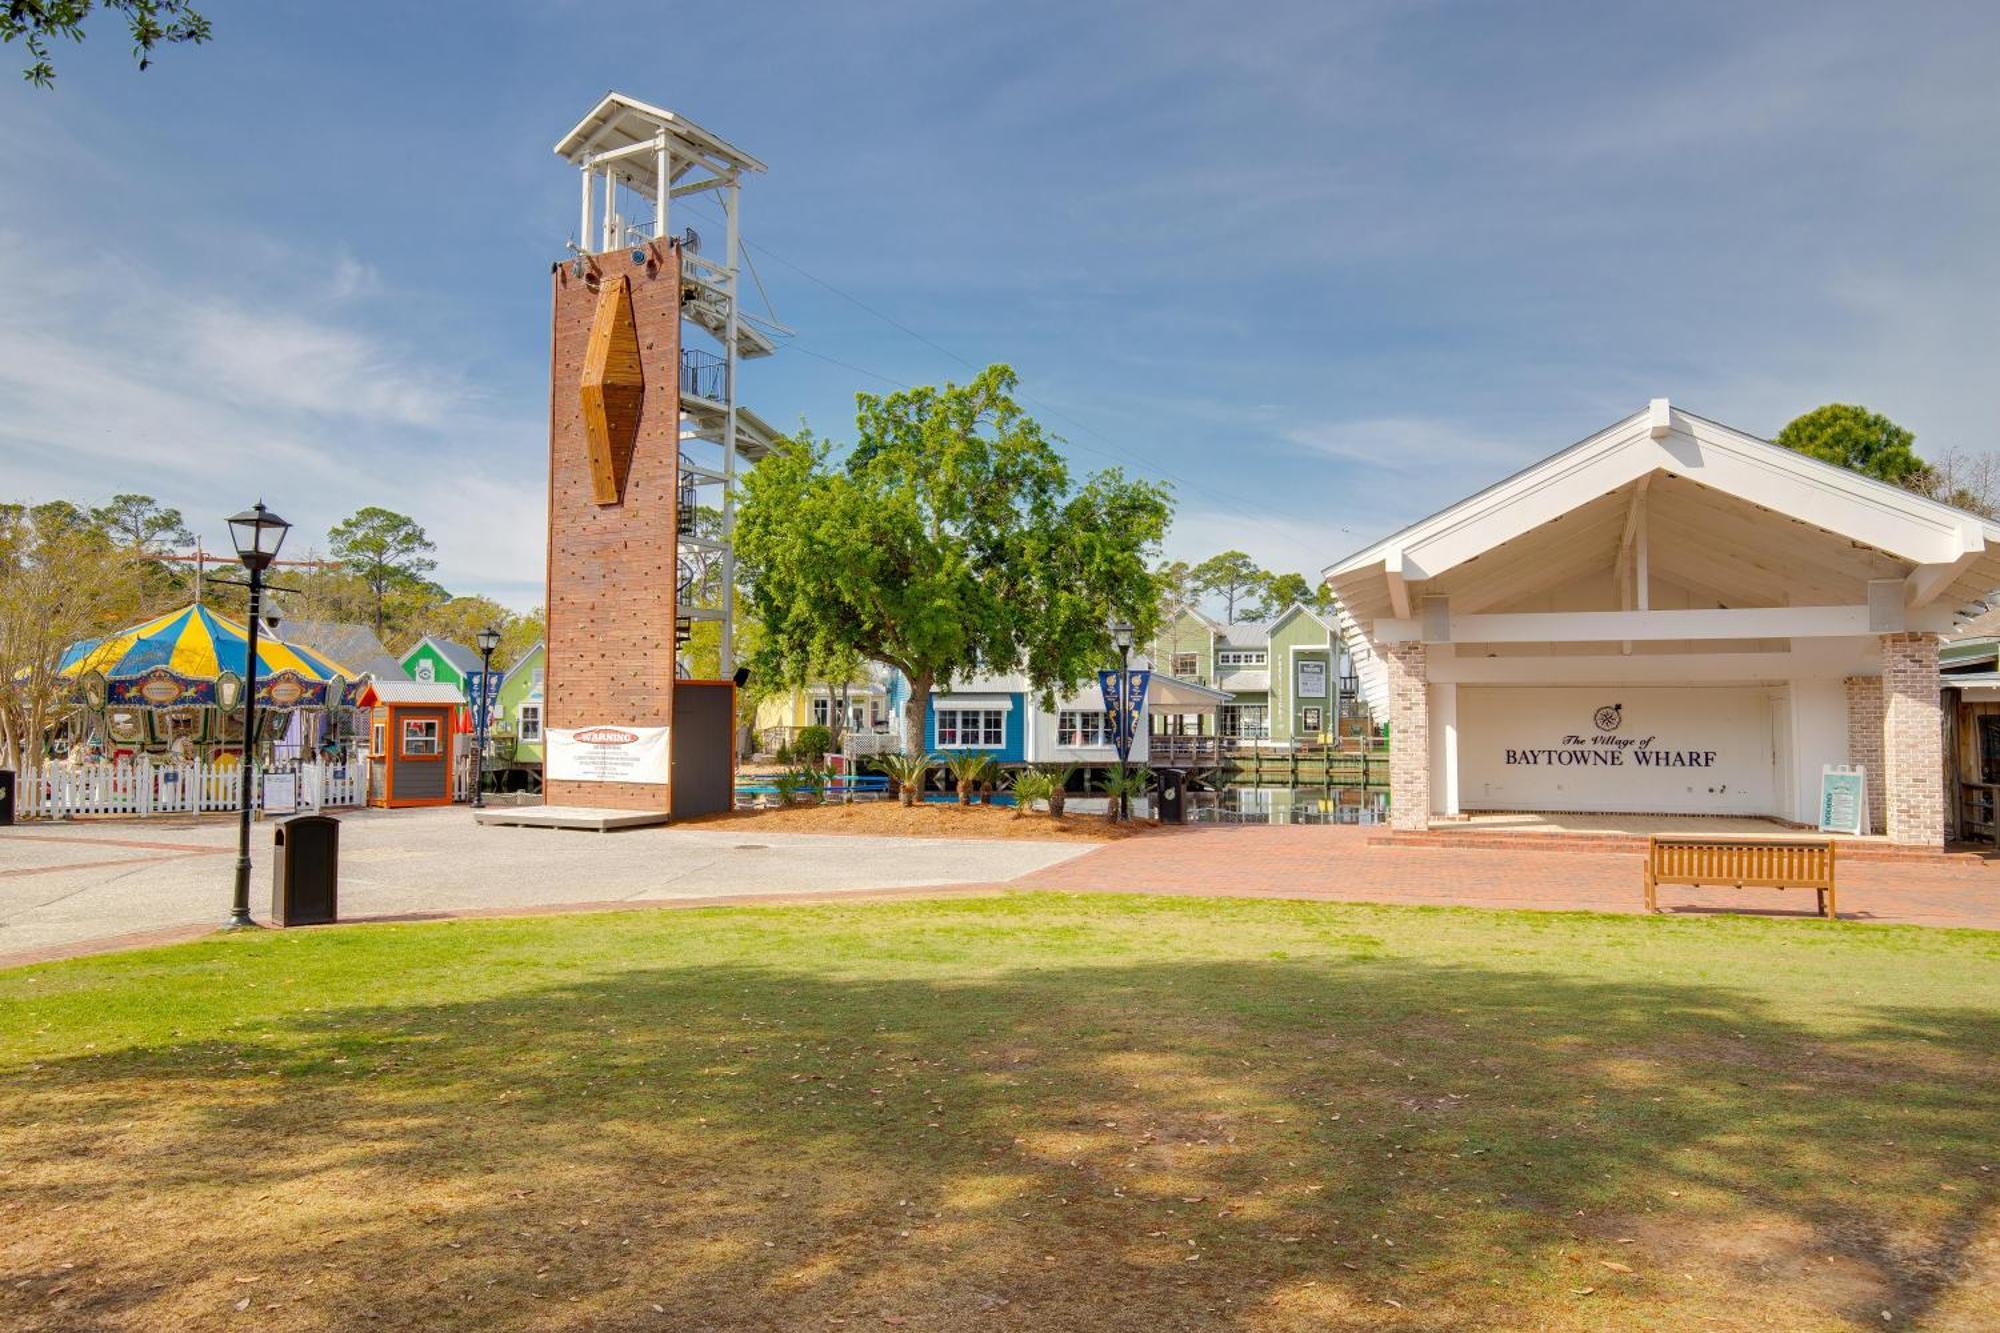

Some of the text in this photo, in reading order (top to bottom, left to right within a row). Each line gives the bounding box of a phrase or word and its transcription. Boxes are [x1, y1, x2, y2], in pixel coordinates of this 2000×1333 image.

[1562, 735, 1656, 749] The Village of
[1505, 749, 1717, 768] BAYTOWNE WHARF
